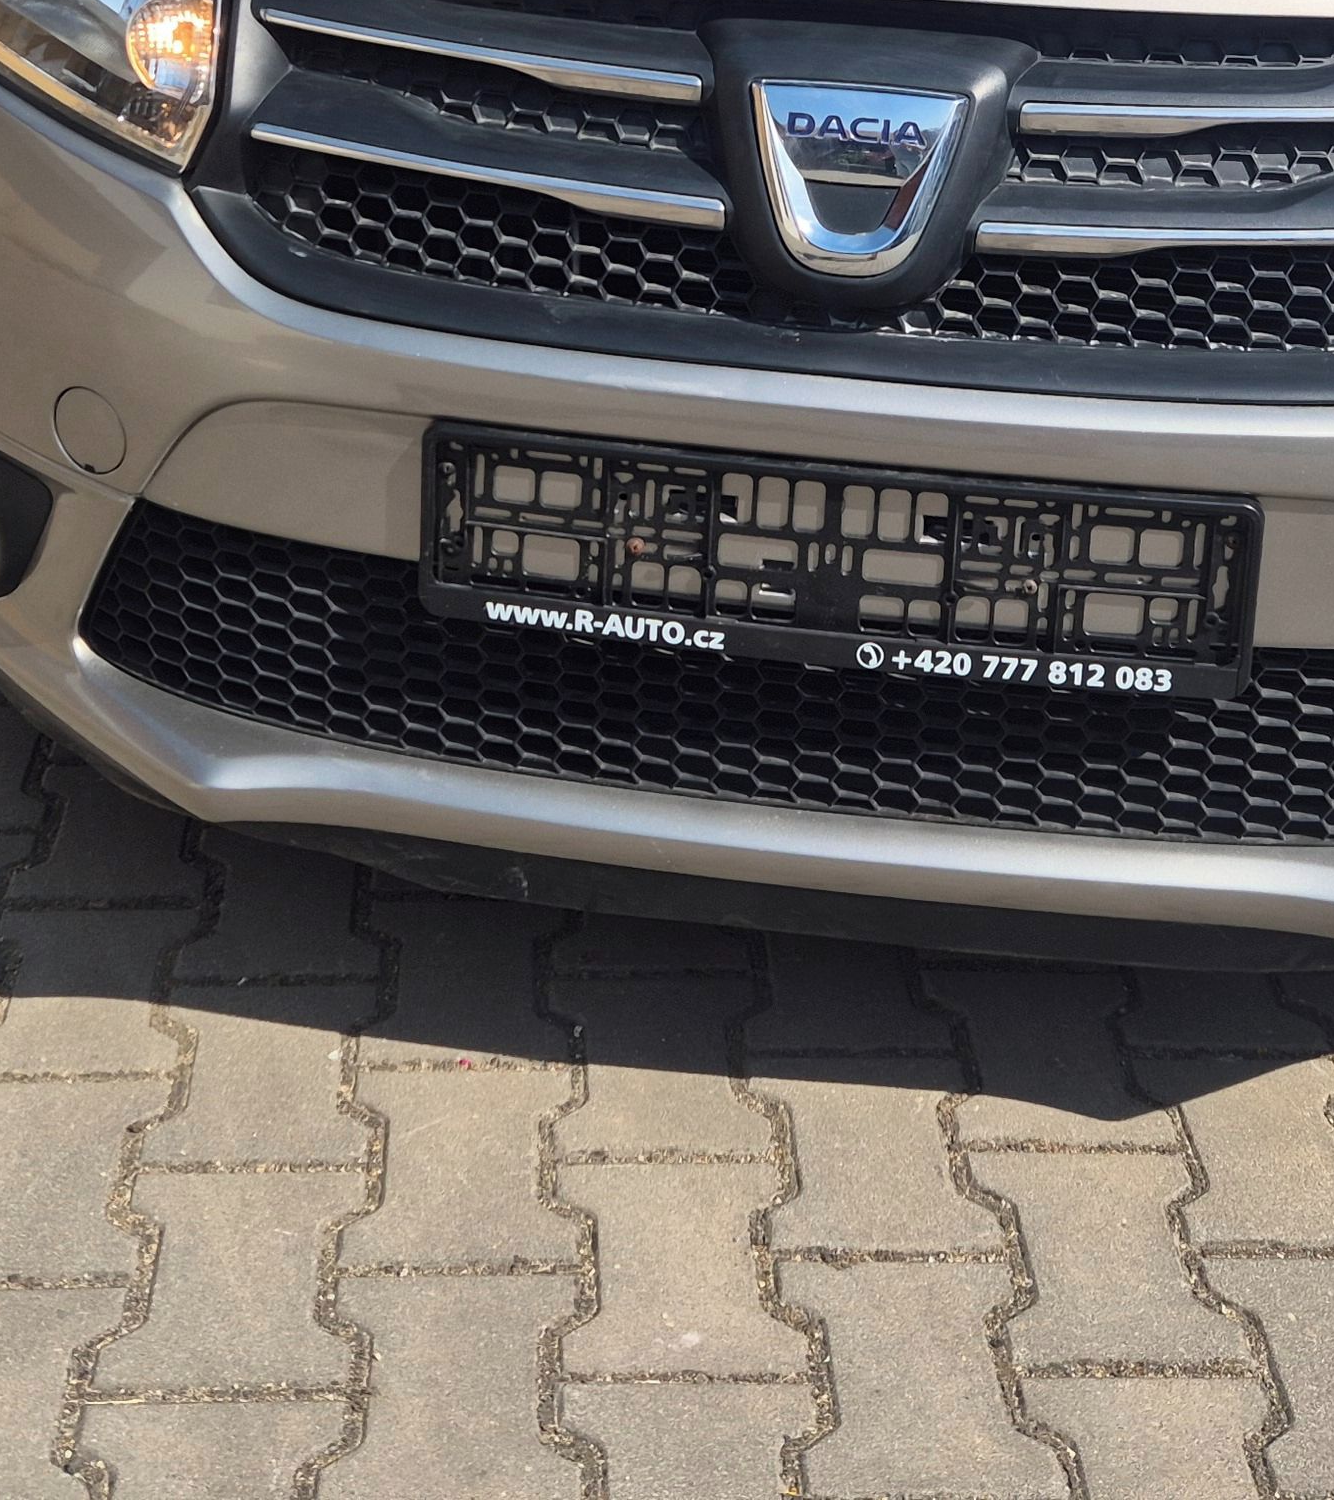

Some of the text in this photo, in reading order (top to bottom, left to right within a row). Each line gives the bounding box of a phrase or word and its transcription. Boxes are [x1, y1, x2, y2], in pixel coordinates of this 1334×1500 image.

[785, 111, 927, 150] DACIA
[484, 601, 726, 650] www.R-AUTO.cz
[891, 649, 1172, 692] +420 777 812 083
